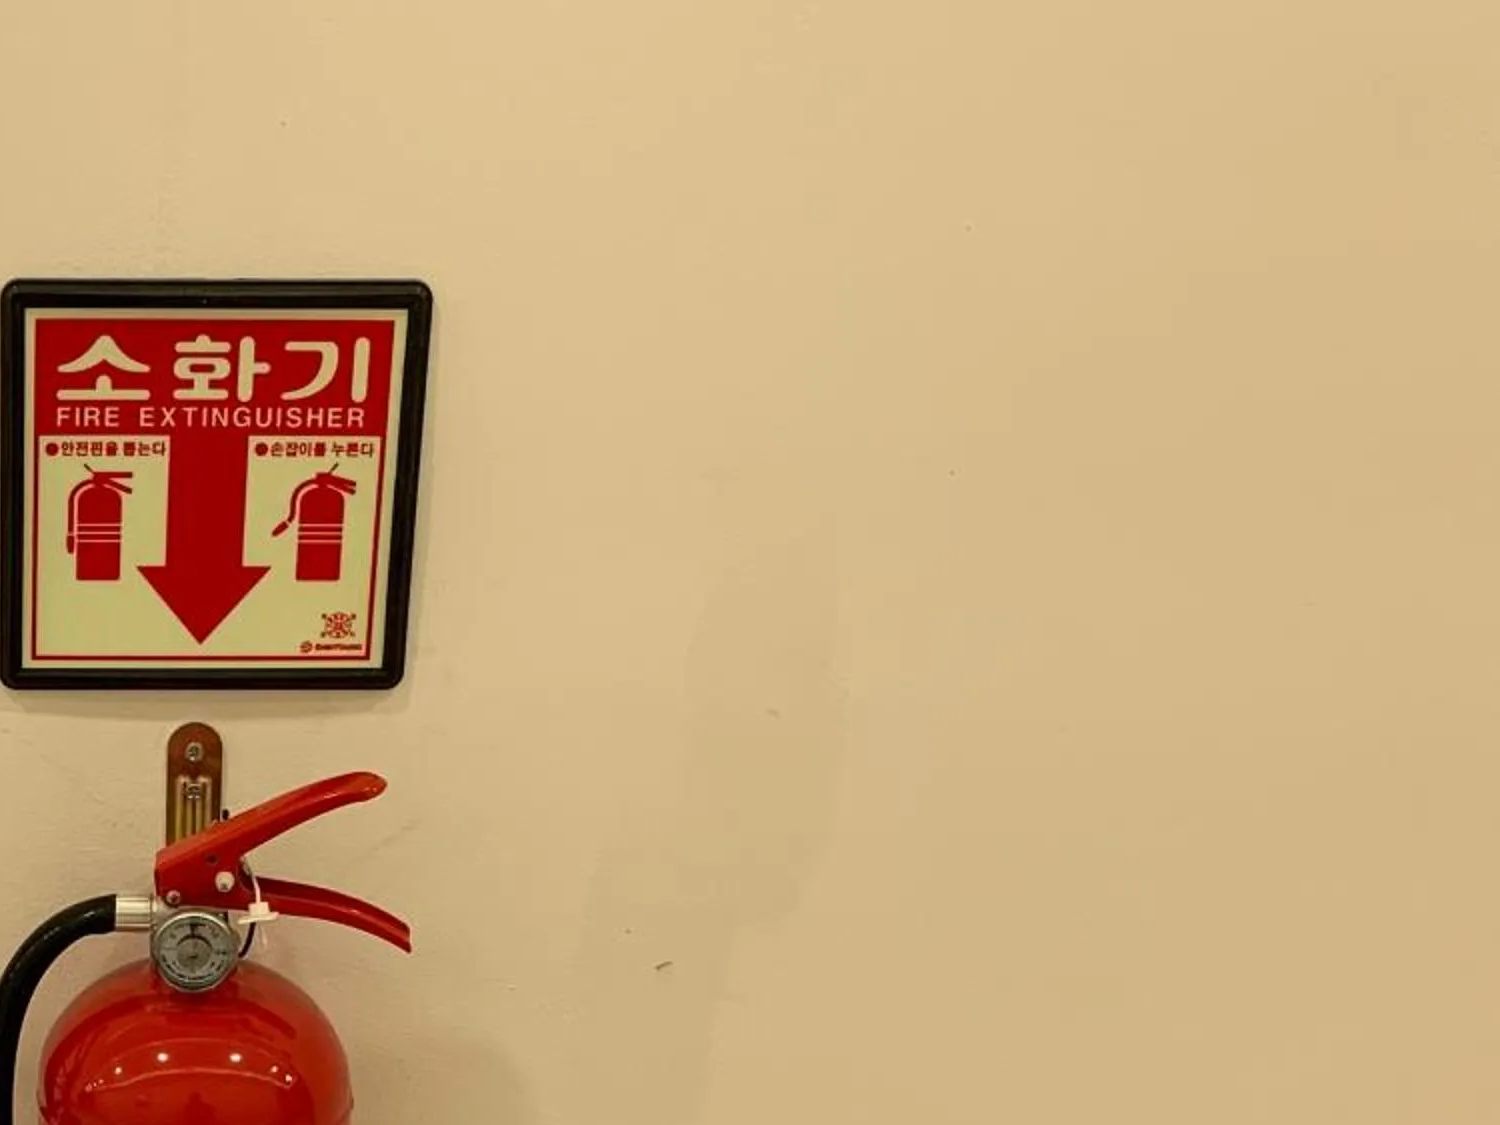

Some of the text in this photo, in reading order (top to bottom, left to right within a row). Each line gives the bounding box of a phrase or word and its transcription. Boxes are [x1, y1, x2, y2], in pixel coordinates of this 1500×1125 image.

[56, 334, 372, 403] 소화기
[56, 406, 366, 428] FIRE EXTINGUISHER
[332, 441, 374, 458] 누른다
